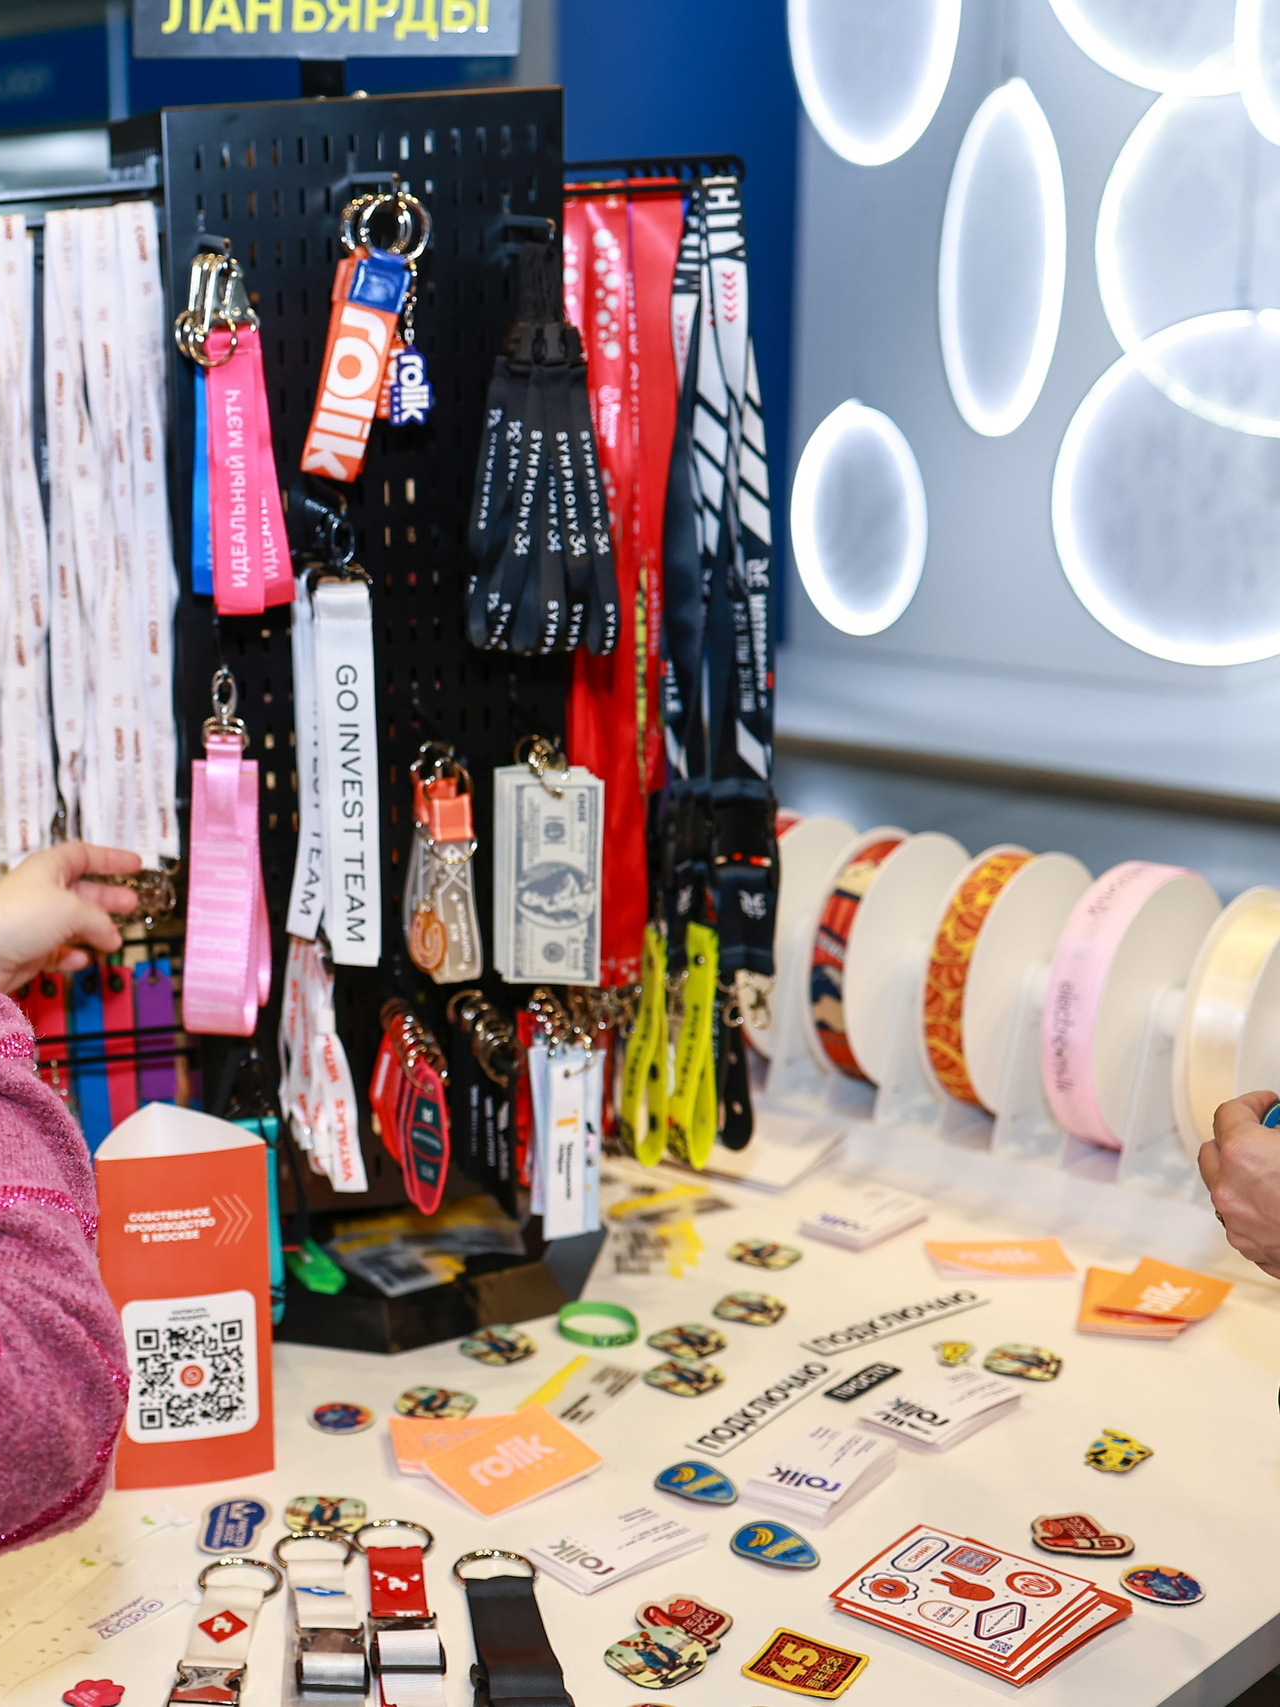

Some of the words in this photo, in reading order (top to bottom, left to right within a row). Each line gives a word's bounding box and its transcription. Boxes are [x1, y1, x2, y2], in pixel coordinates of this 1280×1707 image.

[302, 305, 387, 482] rolik
[399, 354, 430, 422] rolik
[224, 389, 245, 449] МЭТЧ
[516, 429, 545, 531] SYMPHONY
[555, 430, 579, 531] SYMPHONY
[579, 430, 603, 530] SYMPHONY
[225, 453, 251, 589] ИДЕАЛЬНЫЙ
[335, 663, 360, 713] GO
[338, 723, 364, 841] INVEST
[343, 852, 366, 943] TEAM
[124, 1217, 216, 1234] ПРОИЗВОДСТВО
[128, 1206, 212, 1223] СОБСТВЕННОЕ
[141, 1233, 150, 1243] В
[152, 1230, 201, 1242] МОСКВЕ
[812, 1290, 978, 1350] ПОДКЛЮЧАЮ
[697, 1361, 827, 1449] ПОДКЛЮЧАЮ
[468, 1431, 556, 1488] rolik
[767, 1465, 842, 1492] rolik
[547, 1537, 616, 1576] rolik
[691, 1613, 720, 1636] БОСС
[771, 1643, 821, 1681] 45
